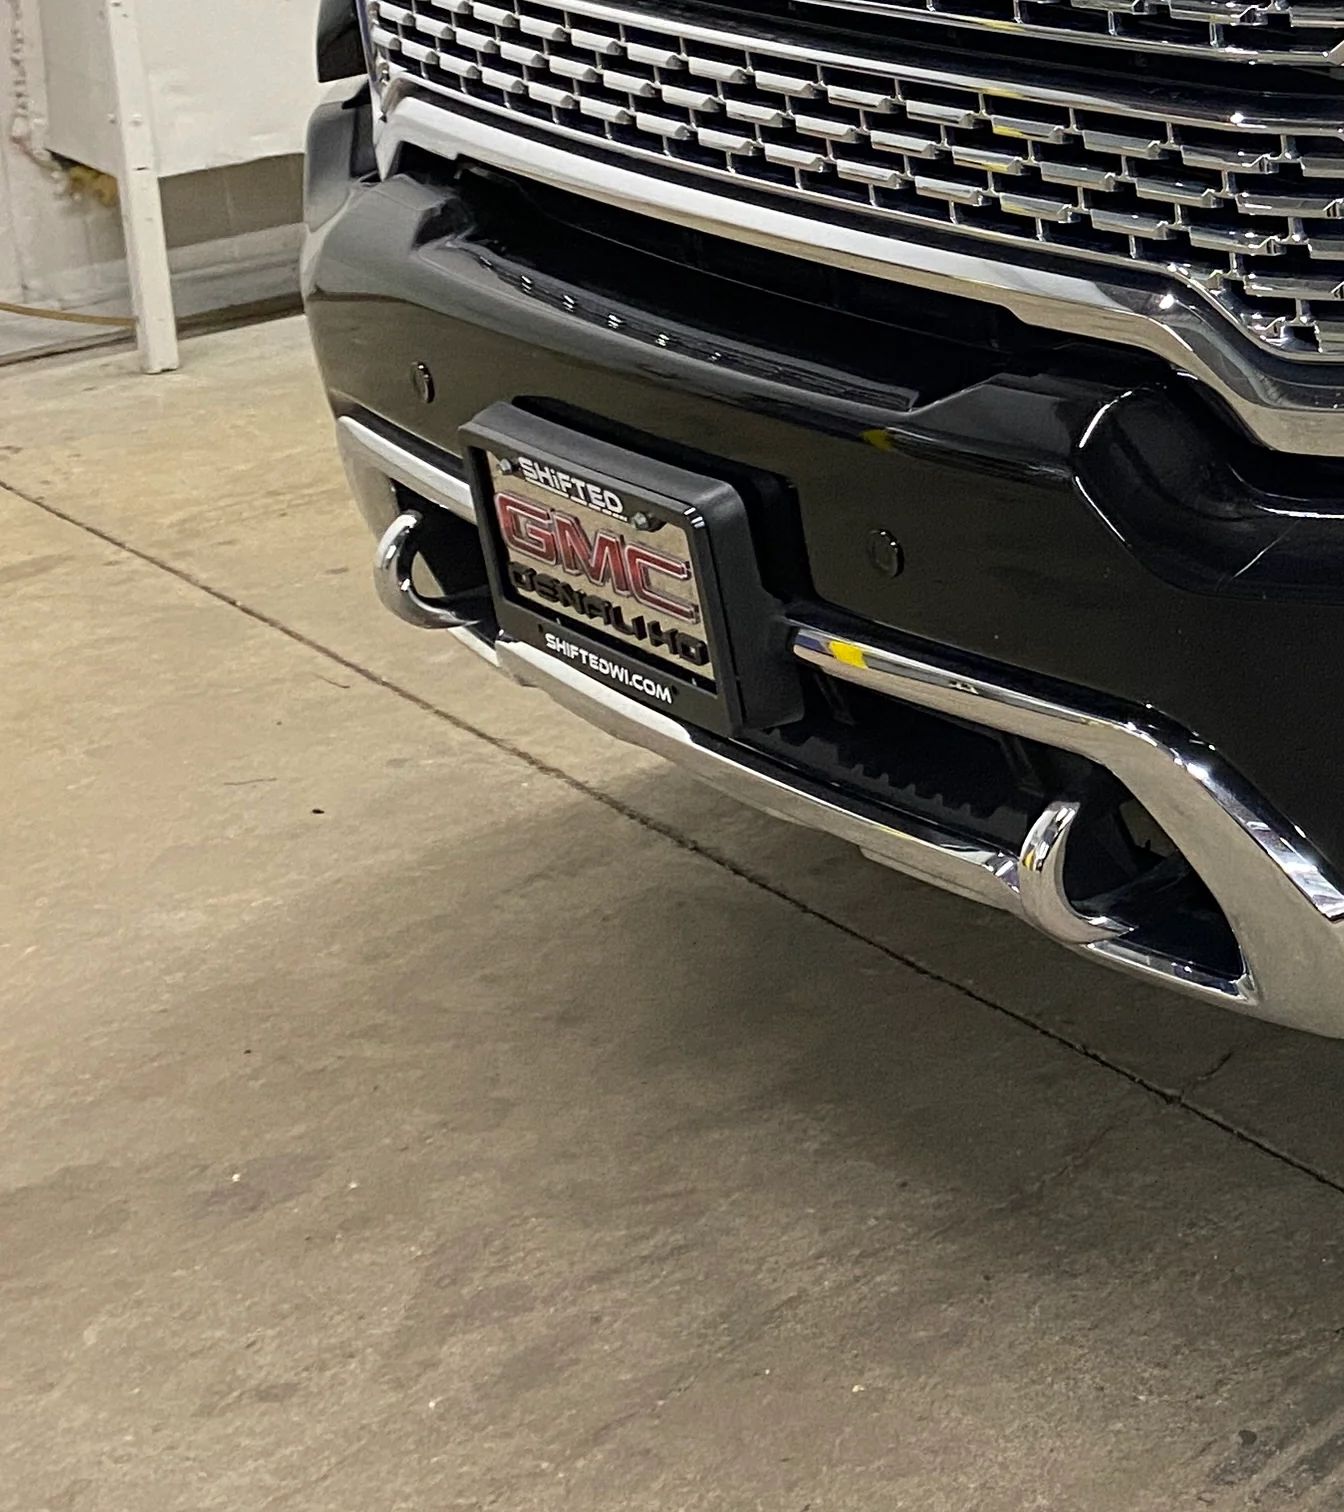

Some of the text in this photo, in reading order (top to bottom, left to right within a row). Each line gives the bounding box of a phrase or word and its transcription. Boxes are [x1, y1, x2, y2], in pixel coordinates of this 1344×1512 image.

[494, 489, 702, 625] GMC
[508, 561, 711, 668] DENALI HD
[545, 632, 673, 705] SHIFTEDWI.COM
